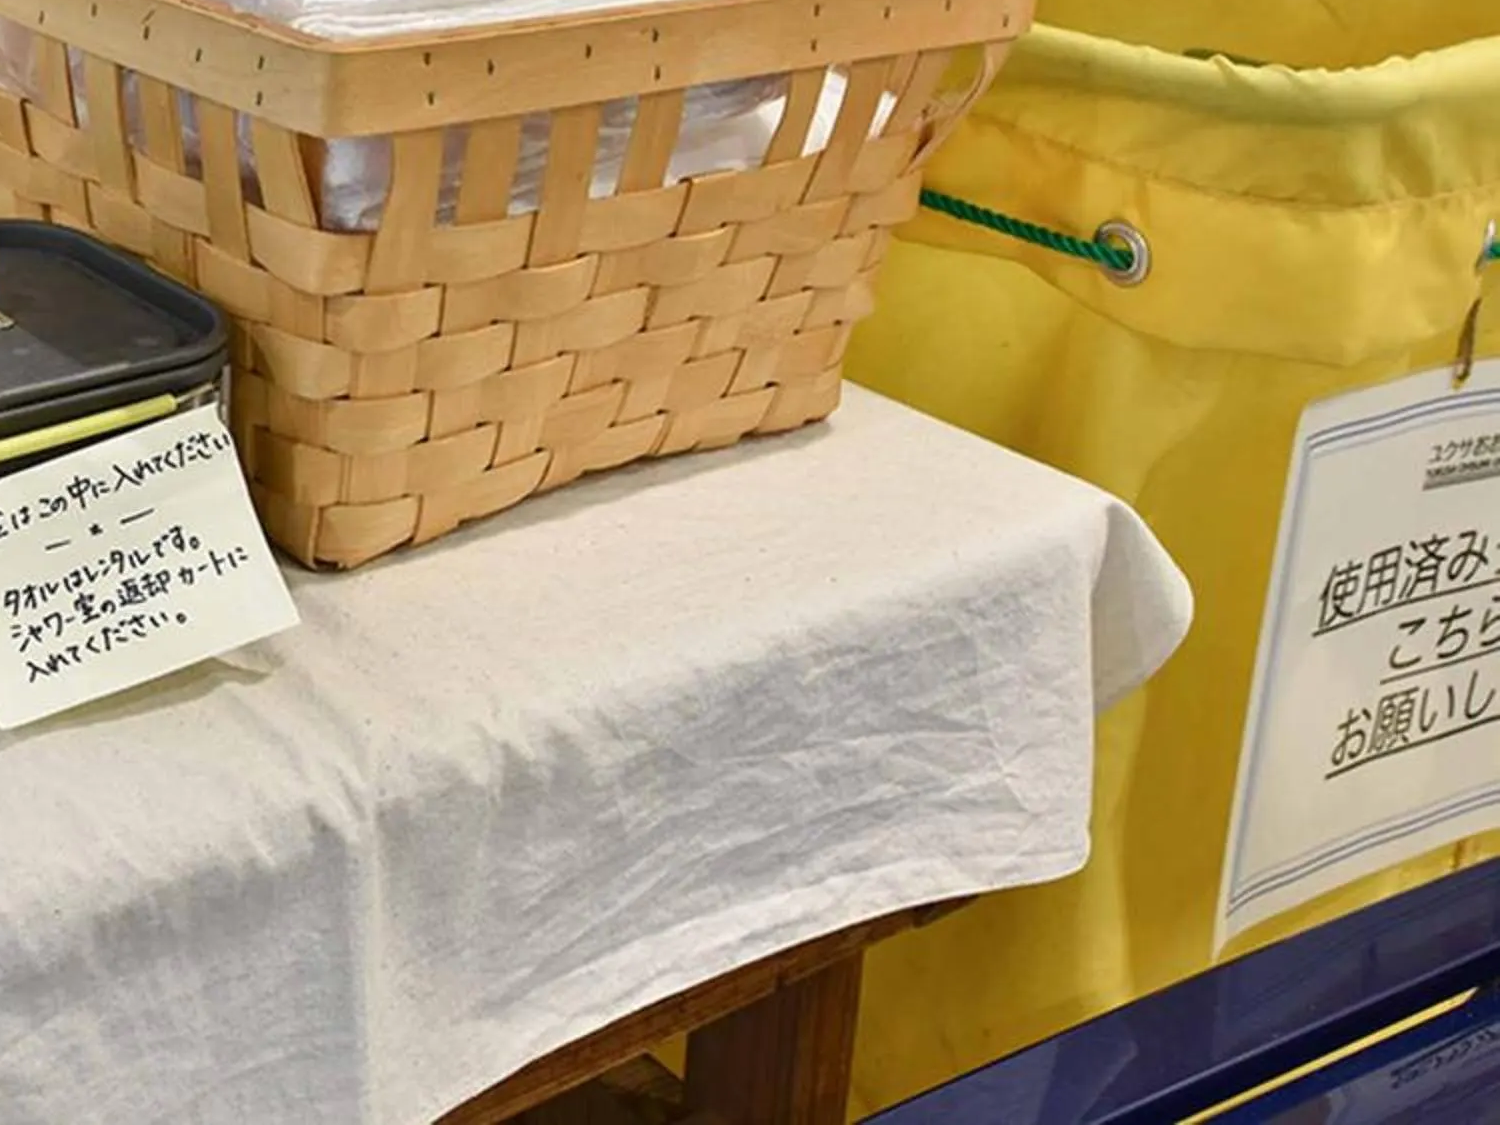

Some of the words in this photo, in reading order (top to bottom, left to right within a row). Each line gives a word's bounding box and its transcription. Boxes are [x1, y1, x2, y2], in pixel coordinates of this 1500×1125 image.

[3, 526, 201, 616] タオルはレンタルです。
[1319, 530, 1500, 627] 使用済み
[26, 612, 188, 683] 入れてください。
[1331, 670, 1496, 767] お願いし
